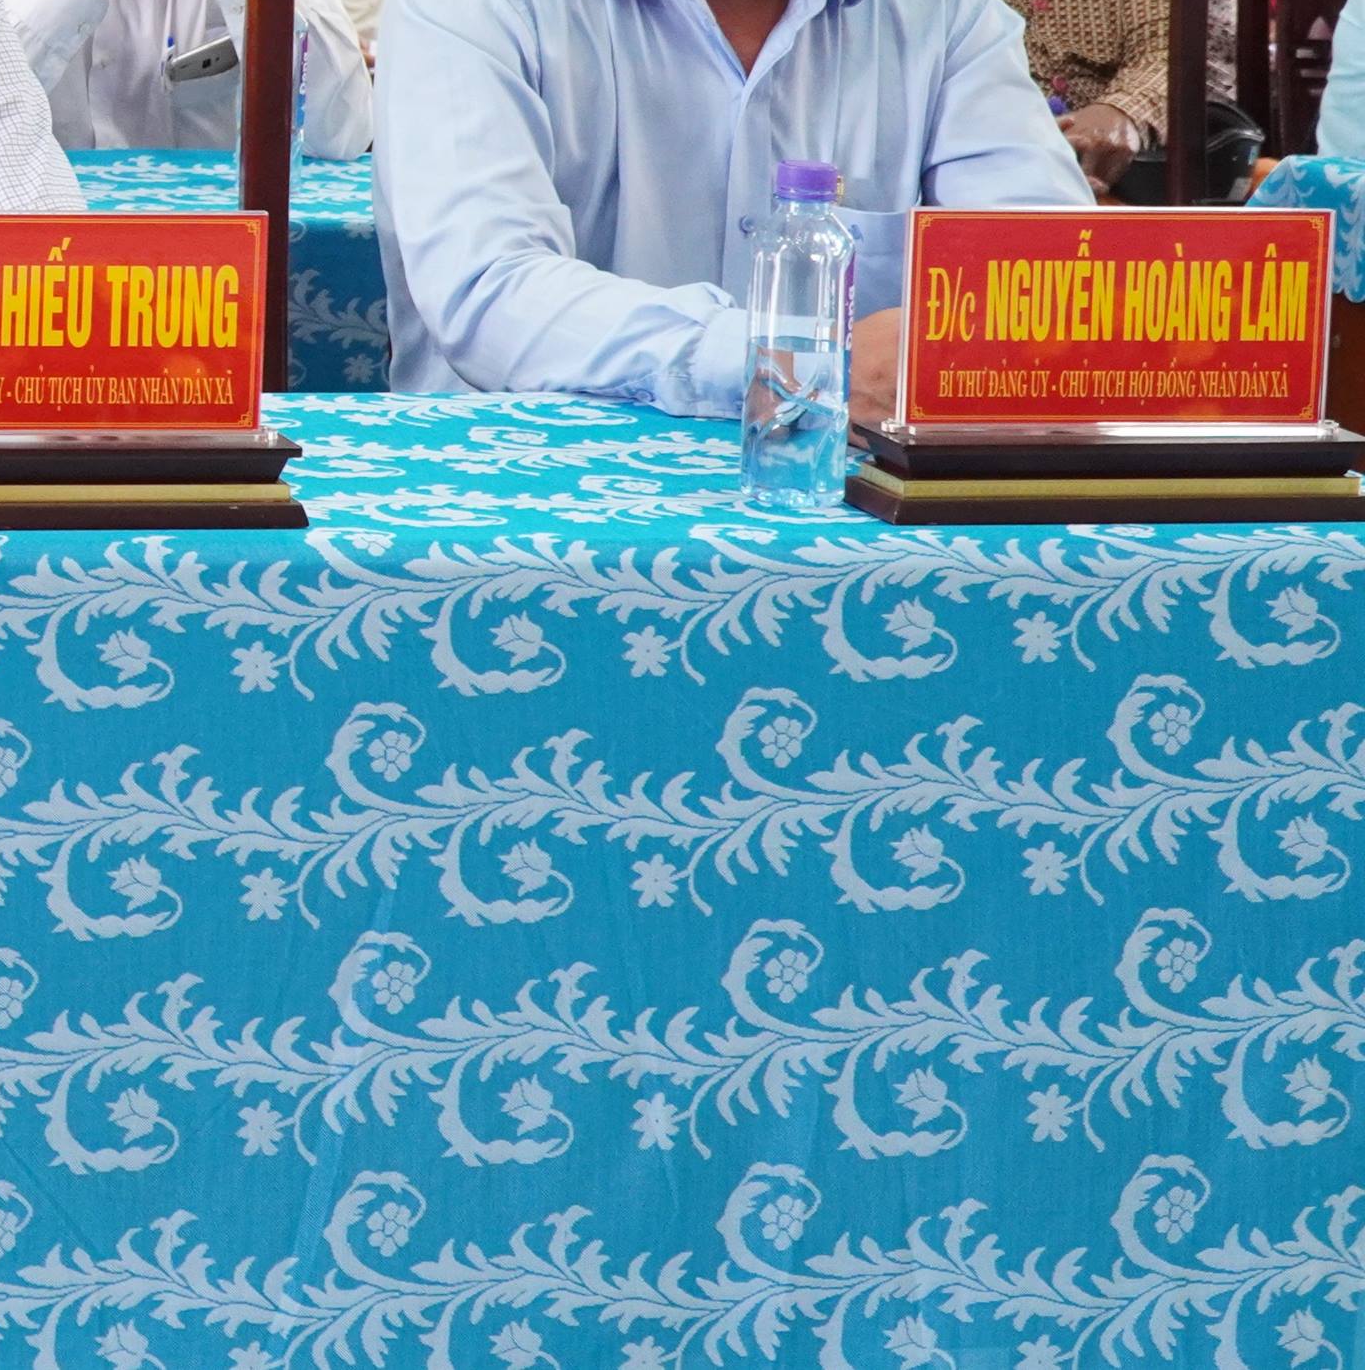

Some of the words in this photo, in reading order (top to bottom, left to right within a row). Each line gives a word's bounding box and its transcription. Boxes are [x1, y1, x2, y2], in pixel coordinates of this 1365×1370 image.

[0, 237, 94, 348] HIẾU
[106, 264, 239, 348] TRUNG
[925, 266, 976, 342] Đ/c
[985, 229, 1116, 342] NGUYỄN
[1123, 242, 1232, 343] HOÀNG
[1240, 243, 1309, 343] LÂM
[14, 364, 46, 404] CHỦ
[48, 377, 81, 411] TỊCH
[85, 364, 105, 404] ỦY
[108, 377, 137, 404] BAN
[215, 369, 234, 404] XÃ
[938, 361, 955, 398] BÍ
[956, 367, 987, 398] THƯ
[988, 358, 1028, 398] ĐẢNG
[1030, 358, 1050, 398] ỦY
[1059, 358, 1090, 398] CHỦ
[1092, 370, 1126, 405] TỊCH
[1128, 361, 1155, 406] HỘI
[1156, 357, 1196, 398] ĐỒNG
[1270, 363, 1289, 398] XÃ
